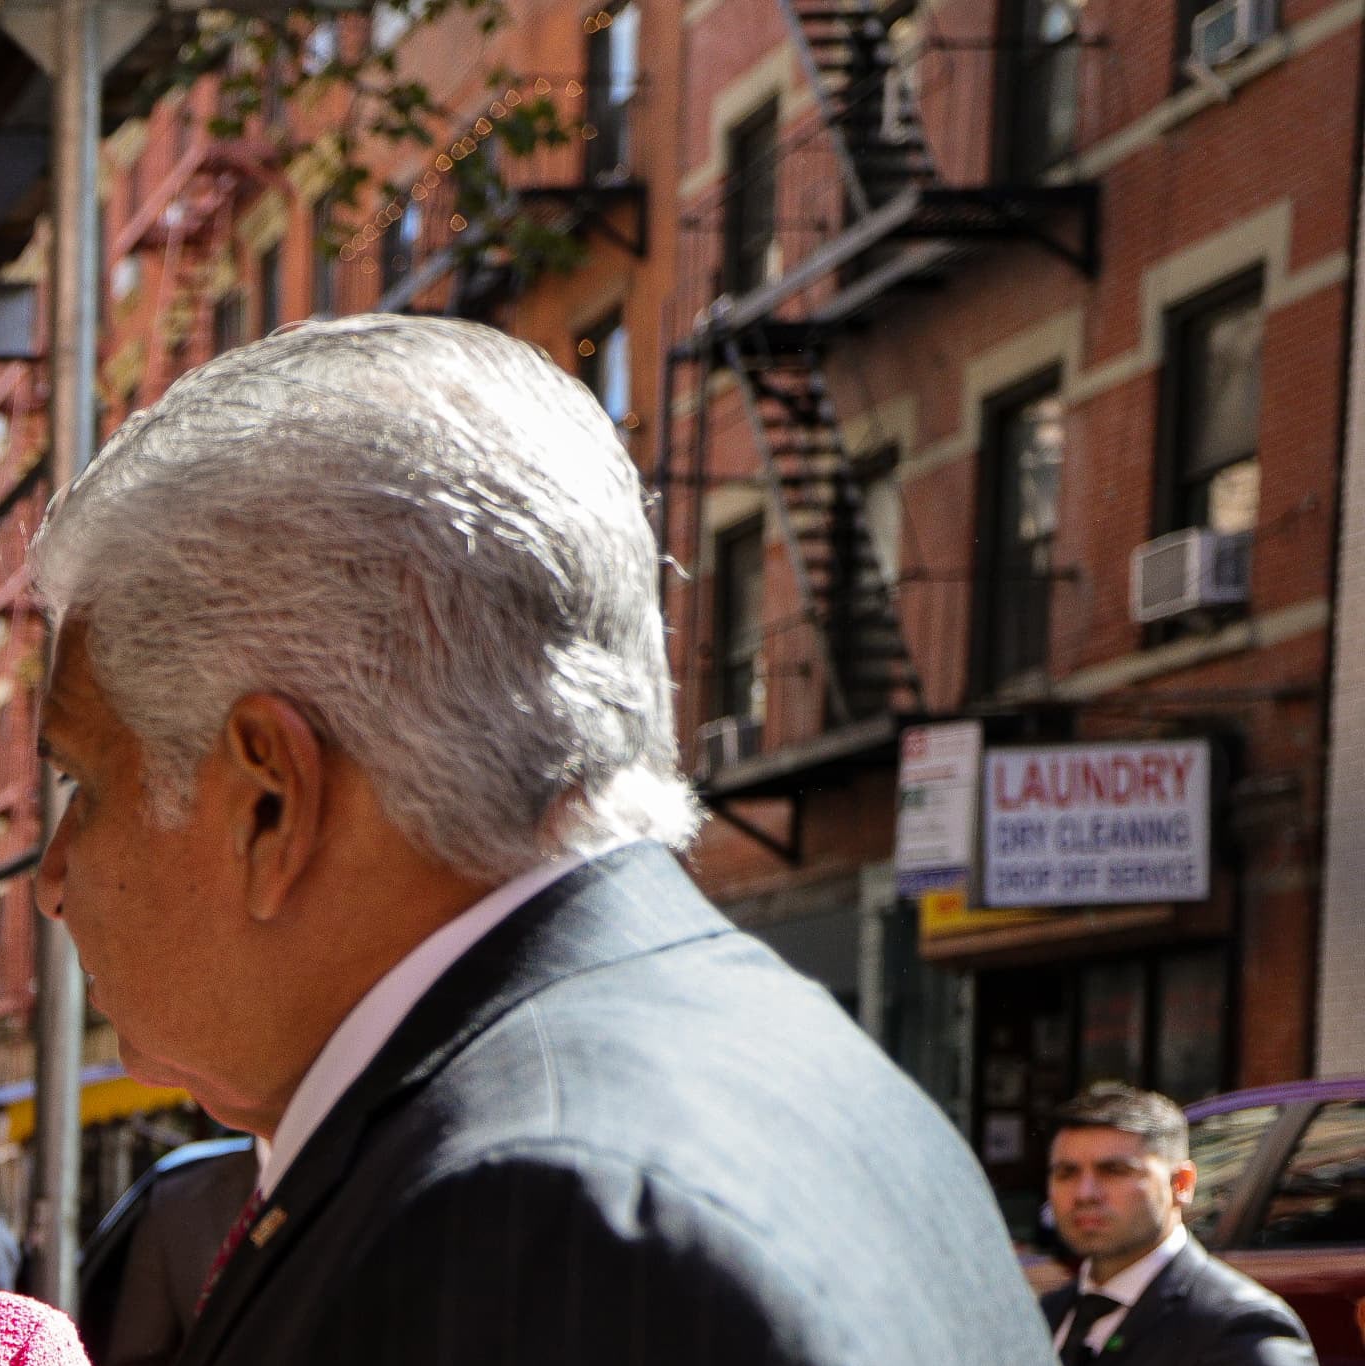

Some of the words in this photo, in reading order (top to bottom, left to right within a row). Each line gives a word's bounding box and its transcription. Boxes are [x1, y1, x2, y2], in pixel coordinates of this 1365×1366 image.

[993, 751, 1195, 812] LAUNDRY
[997, 816, 1046, 856] DRY
[1055, 811, 1191, 854] CLEANING
